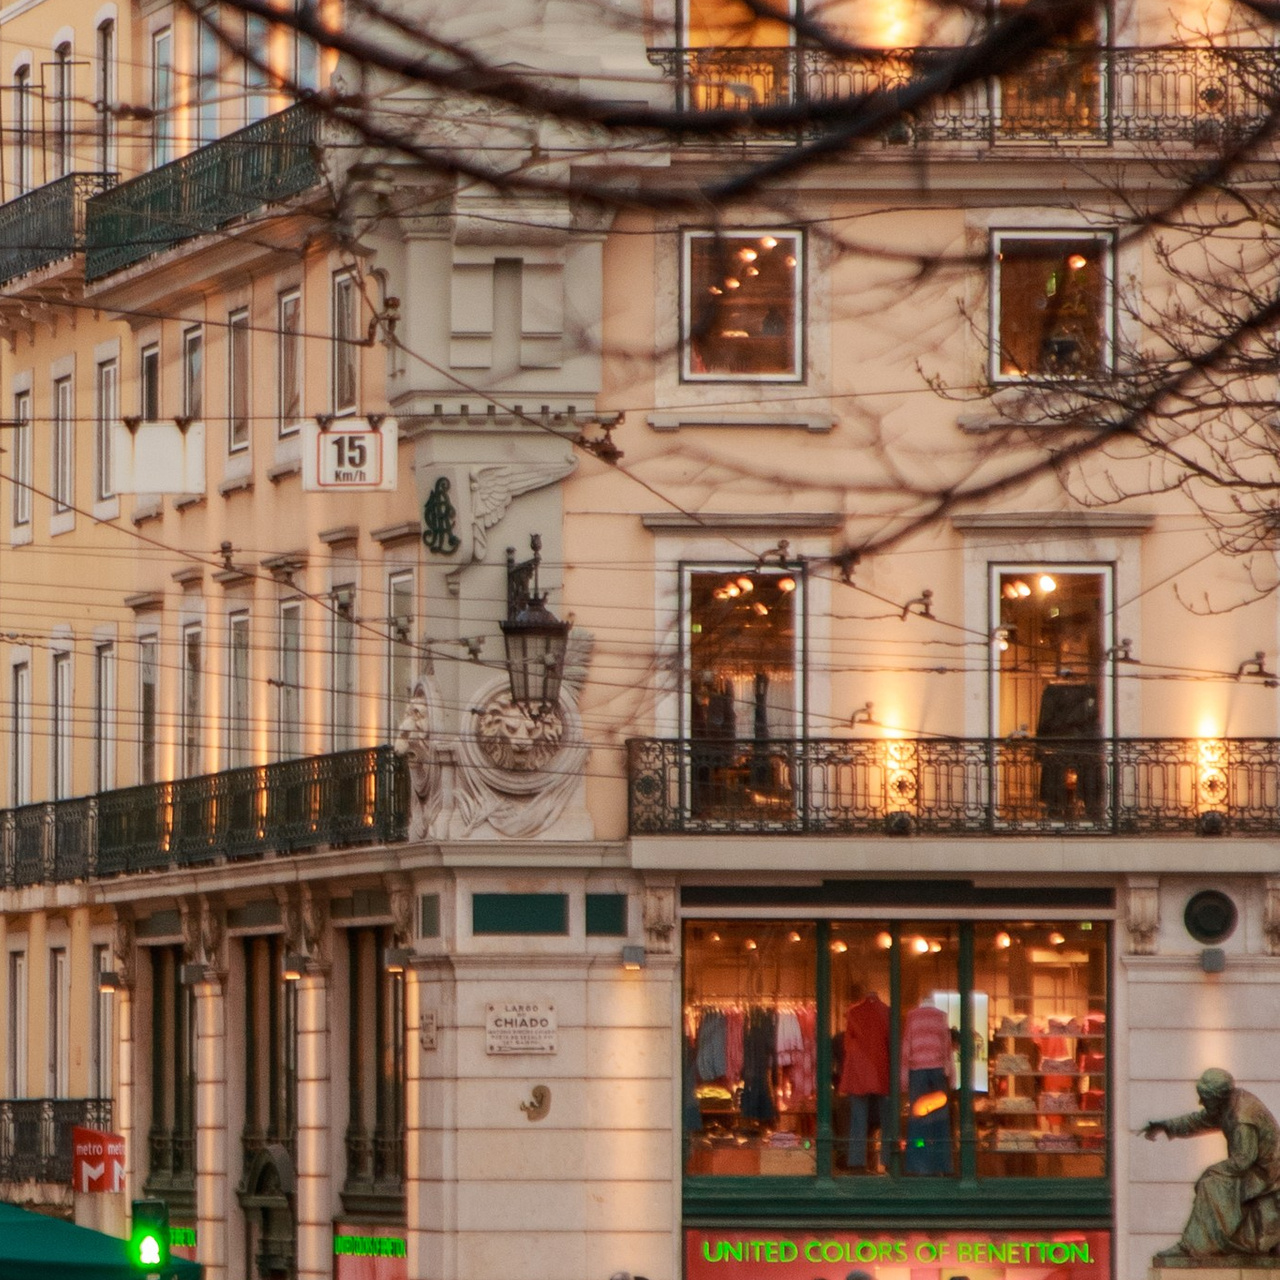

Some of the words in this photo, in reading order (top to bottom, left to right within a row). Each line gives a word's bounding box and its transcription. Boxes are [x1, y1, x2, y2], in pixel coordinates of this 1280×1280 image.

[332, 435, 367, 468] 15
[335, 470, 366, 482] Km/h
[494, 1018, 549, 1028] CHIADO
[76, 1142, 103, 1156] metro
[703, 1240, 798, 1263] UNITED
[805, 1240, 908, 1263] COLORS
[915, 1241, 950, 1263] OF
[957, 1241, 1095, 1264] BENETTON.
